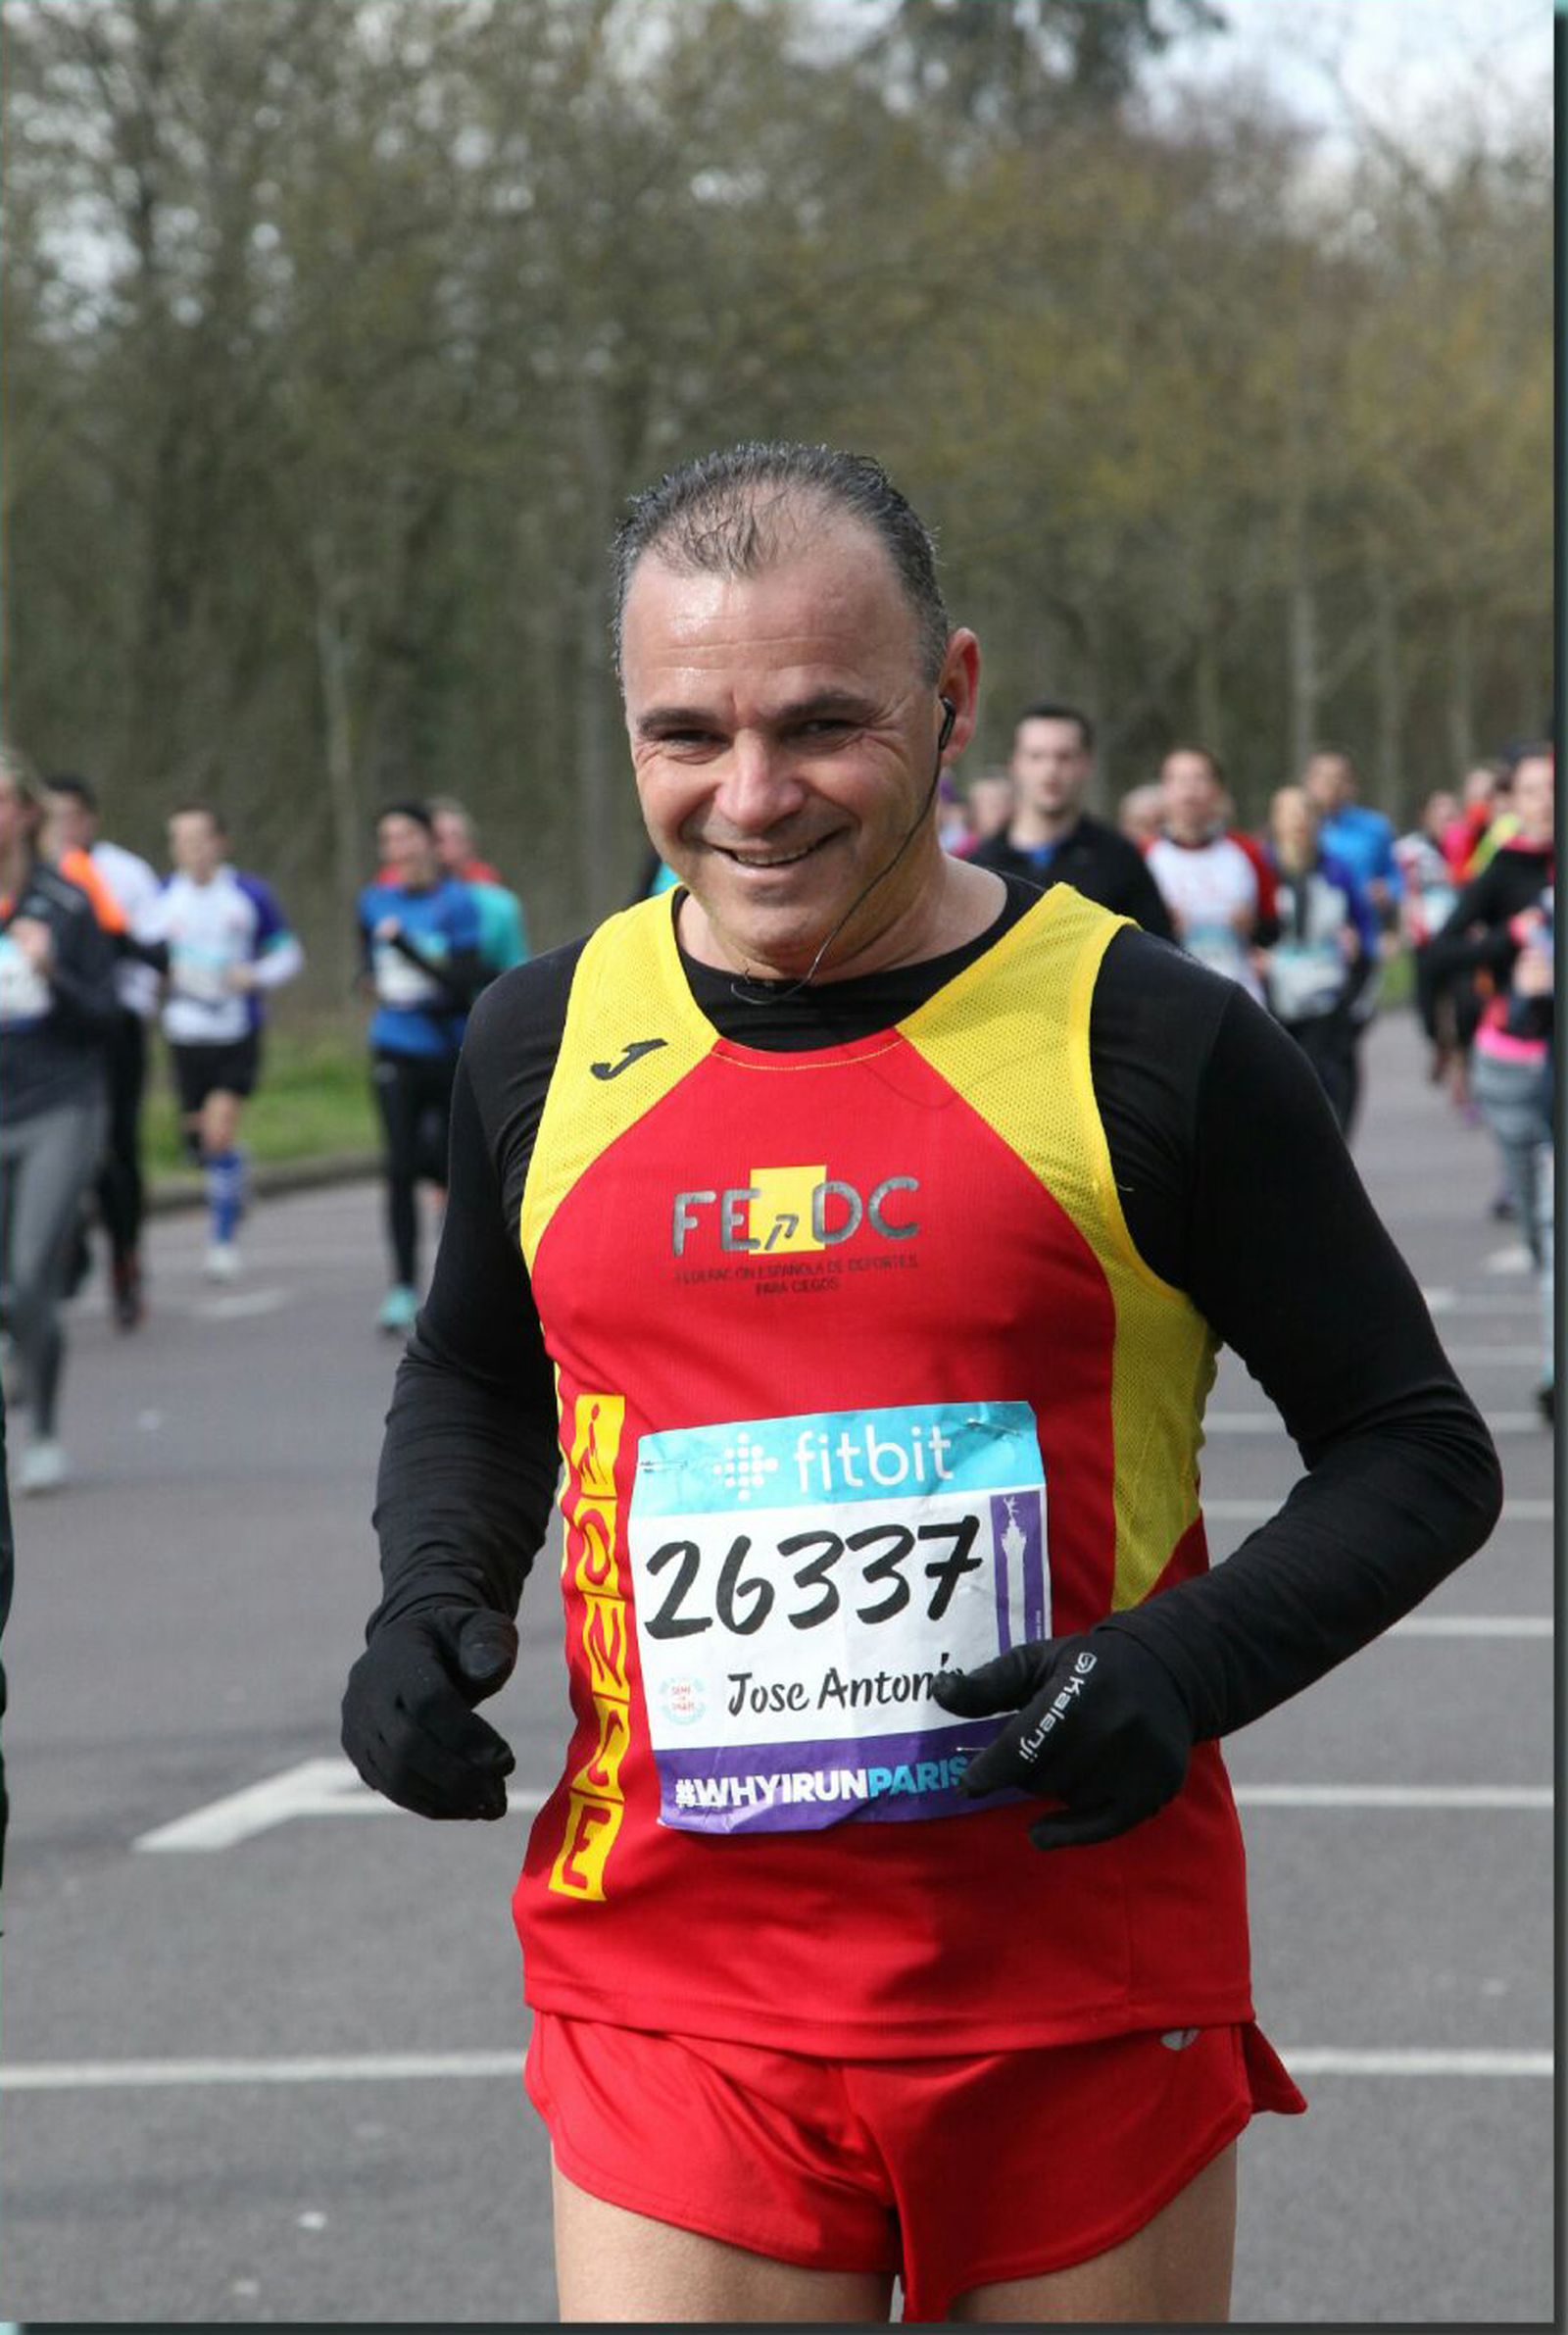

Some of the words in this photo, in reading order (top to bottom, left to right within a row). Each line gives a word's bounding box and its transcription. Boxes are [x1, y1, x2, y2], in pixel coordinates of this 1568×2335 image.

[793, 1424, 955, 1493] fitbit
[644, 1515, 983, 1639] 26337
[727, 1671, 810, 1717] Jose
[817, 1652, 963, 1711] Anton
[675, 1756, 968, 1809] #WHYIRUNPARIS
